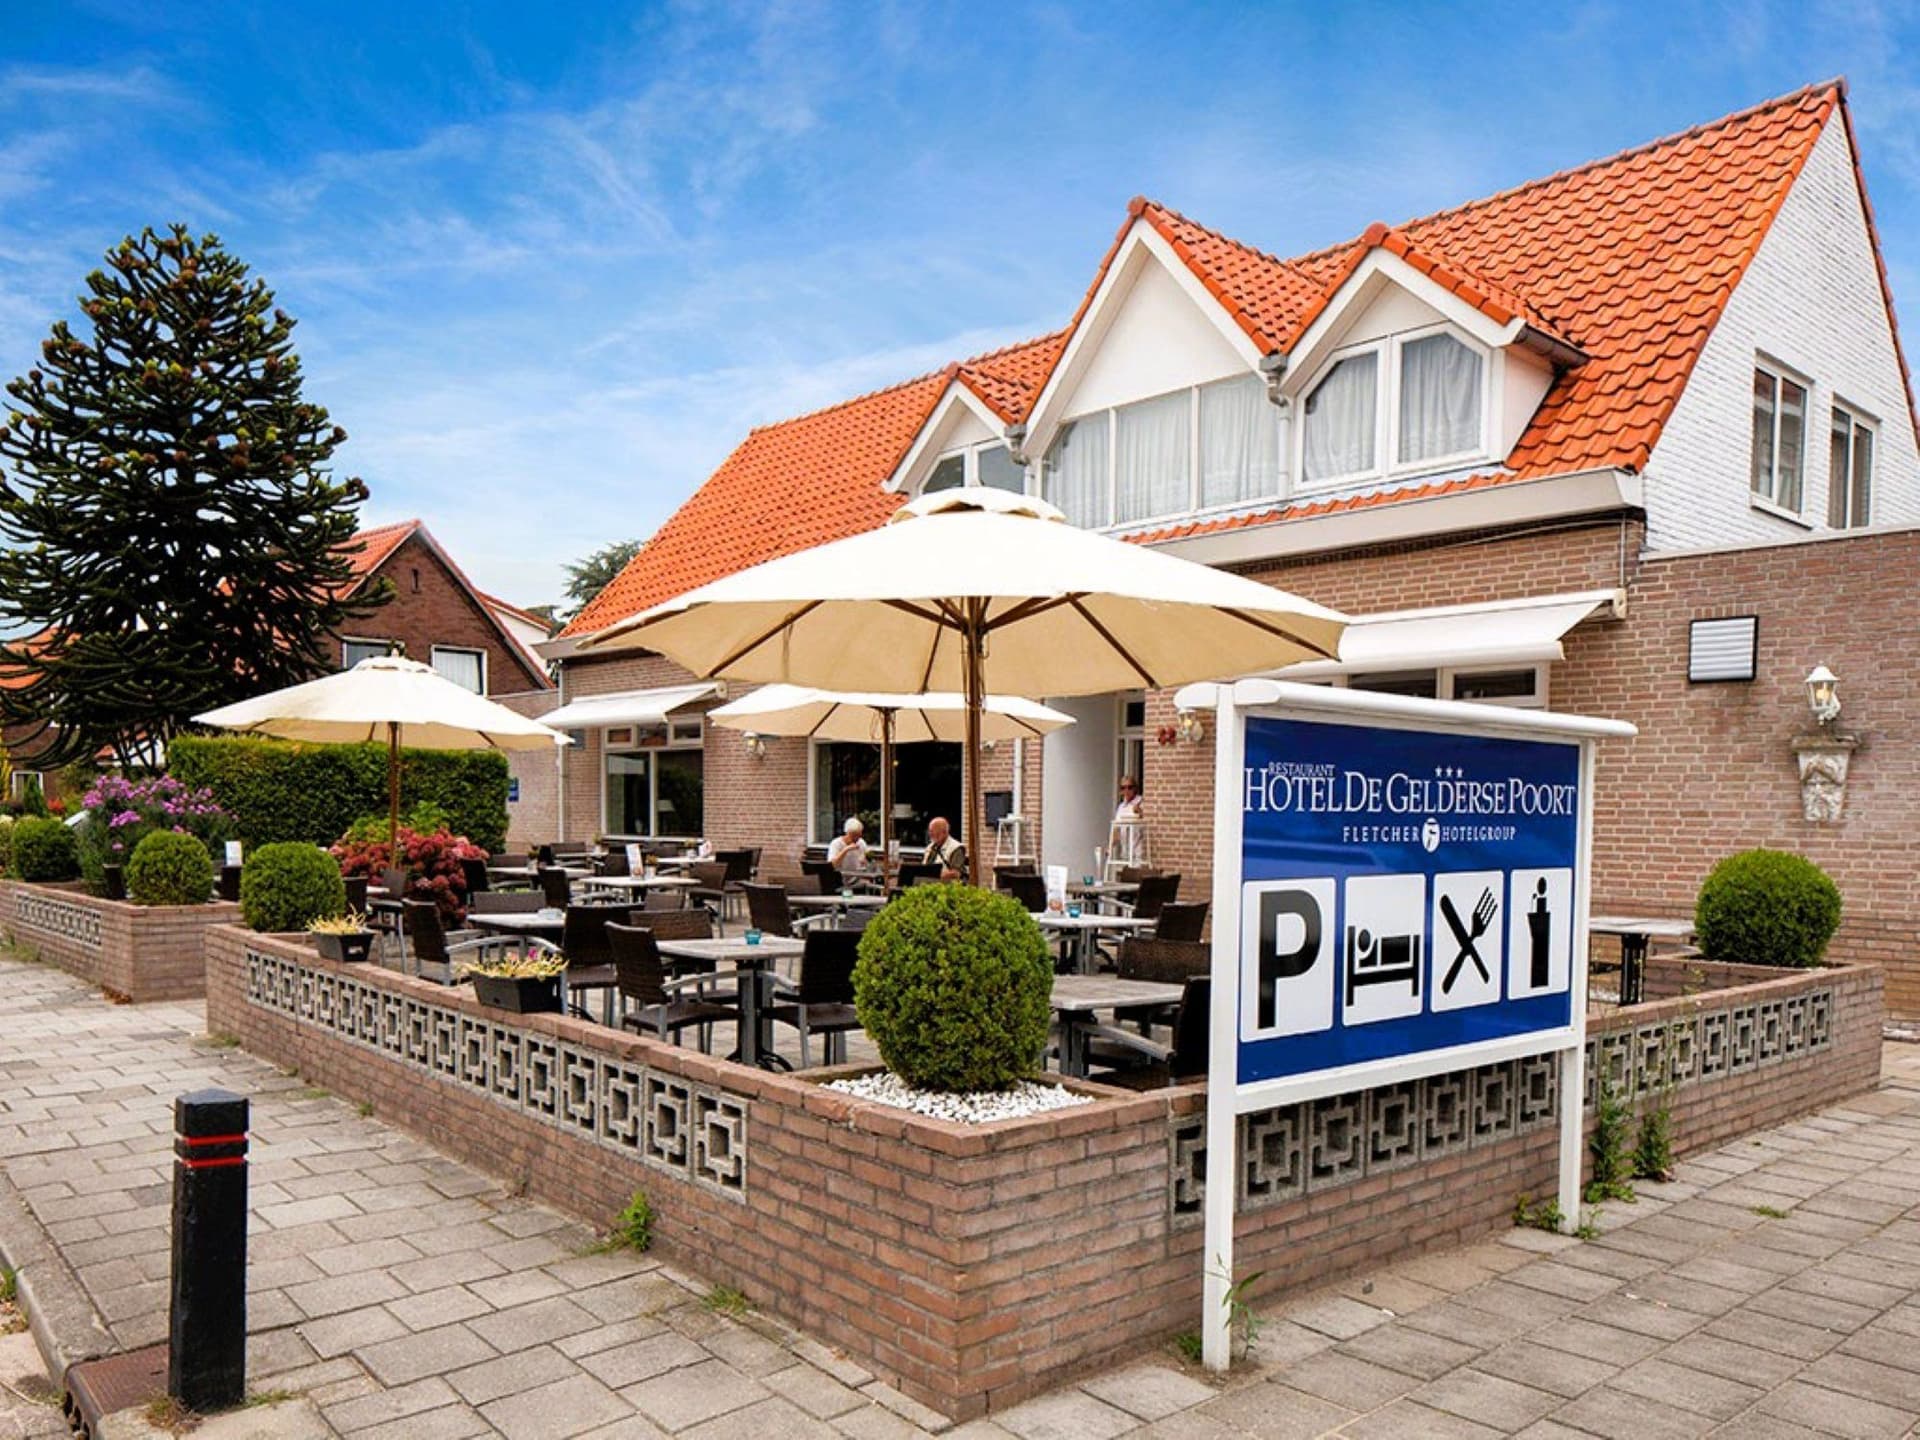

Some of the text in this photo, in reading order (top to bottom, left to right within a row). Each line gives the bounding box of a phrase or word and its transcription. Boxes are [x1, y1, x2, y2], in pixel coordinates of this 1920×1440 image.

[1267, 762, 1335, 777] RESTAURANT
[1244, 767, 1575, 815] HOTEL DE GELDERSE POORT
[1343, 825, 1516, 842] FLETCHER HOTELGROUP
[1258, 888, 1322, 1030] P
